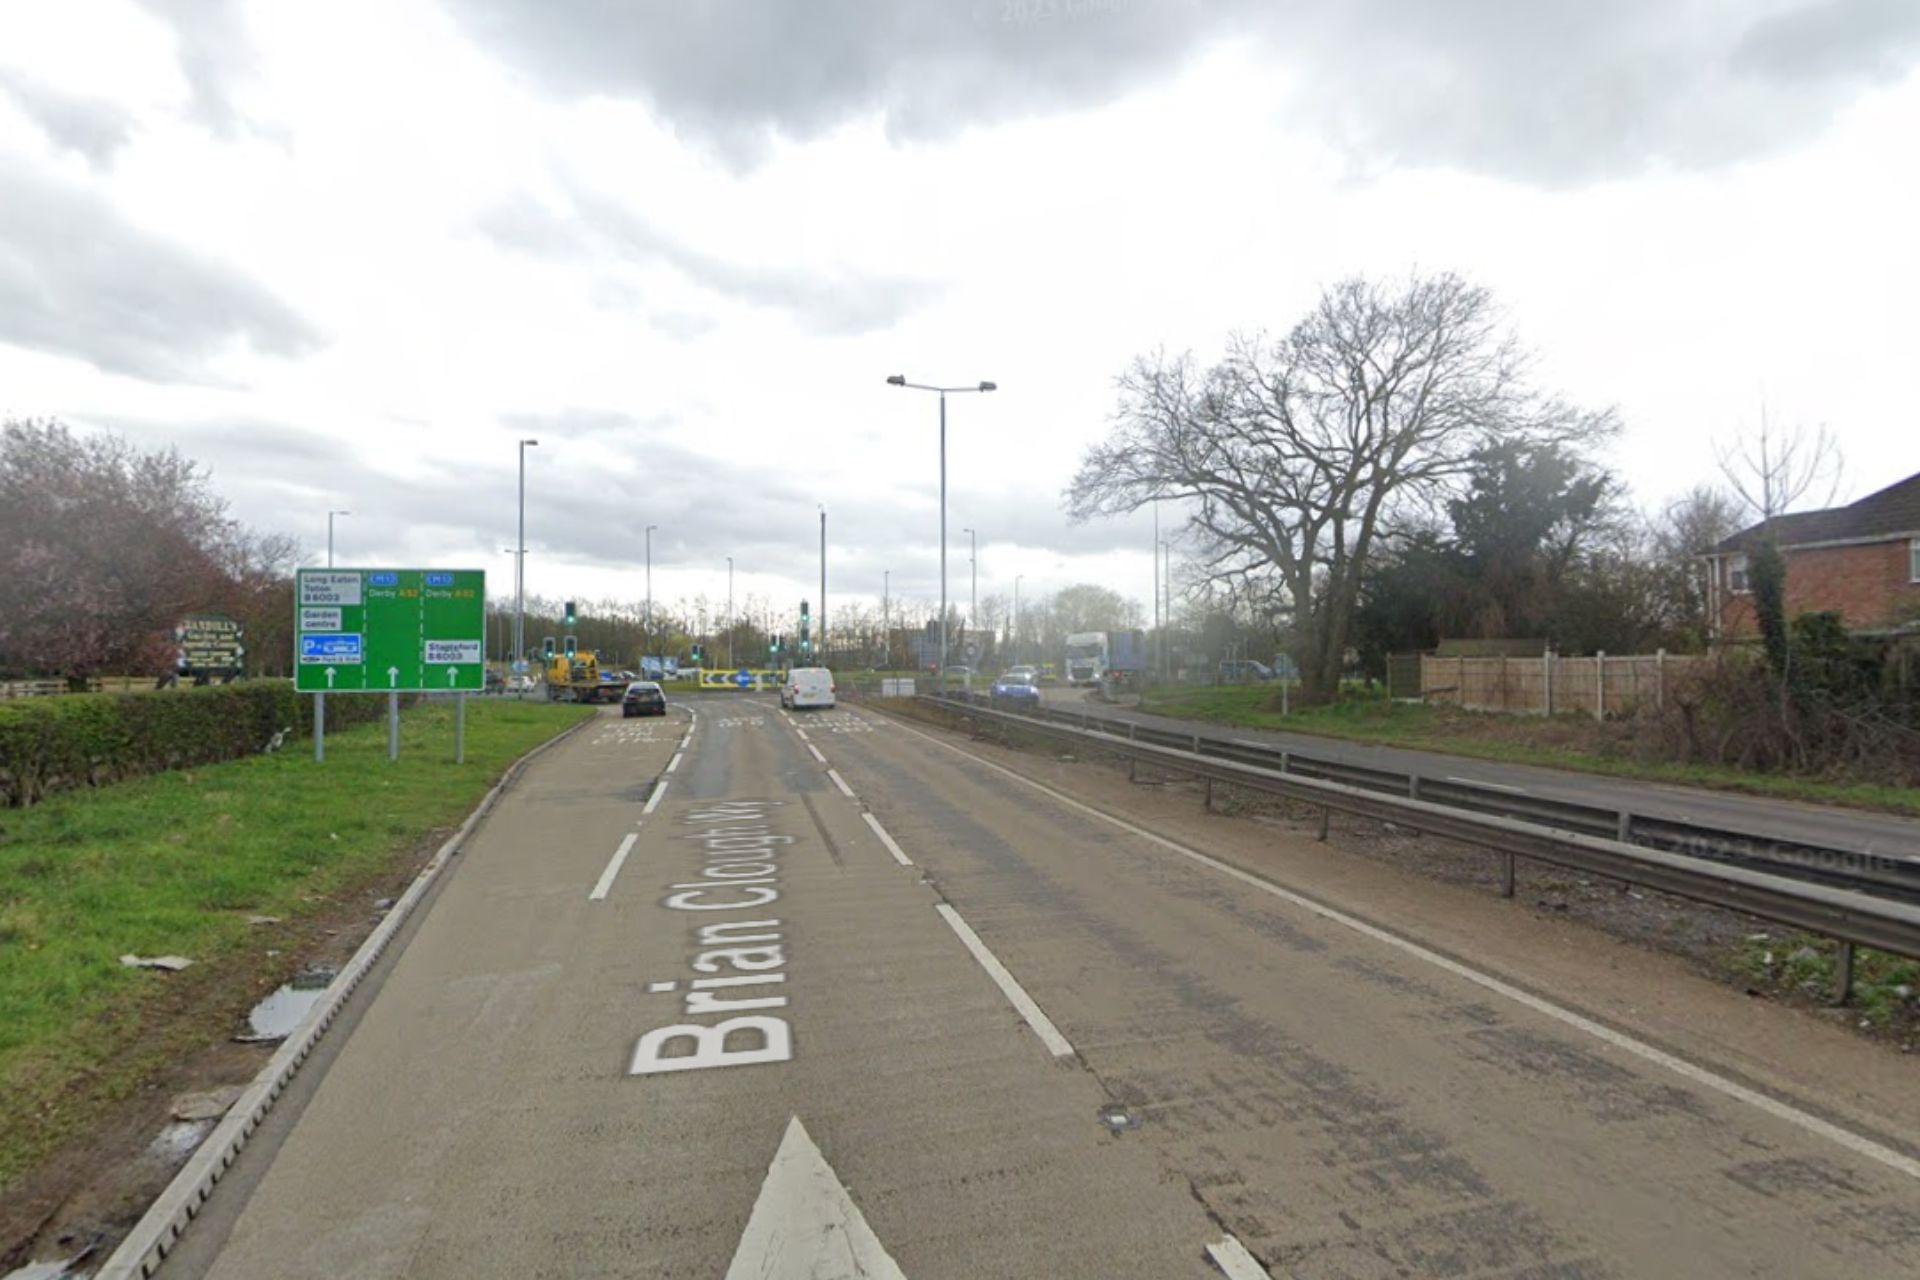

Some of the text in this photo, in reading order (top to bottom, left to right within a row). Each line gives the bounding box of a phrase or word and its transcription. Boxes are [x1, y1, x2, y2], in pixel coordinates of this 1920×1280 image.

[303, 575, 359, 584] Long Eaton
[368, 589, 396, 598] Derby
[425, 589, 452, 598] Derby
[303, 611, 338, 619] Garden
[304, 620, 337, 629] centre
[428, 643, 478, 652] Stapleford
